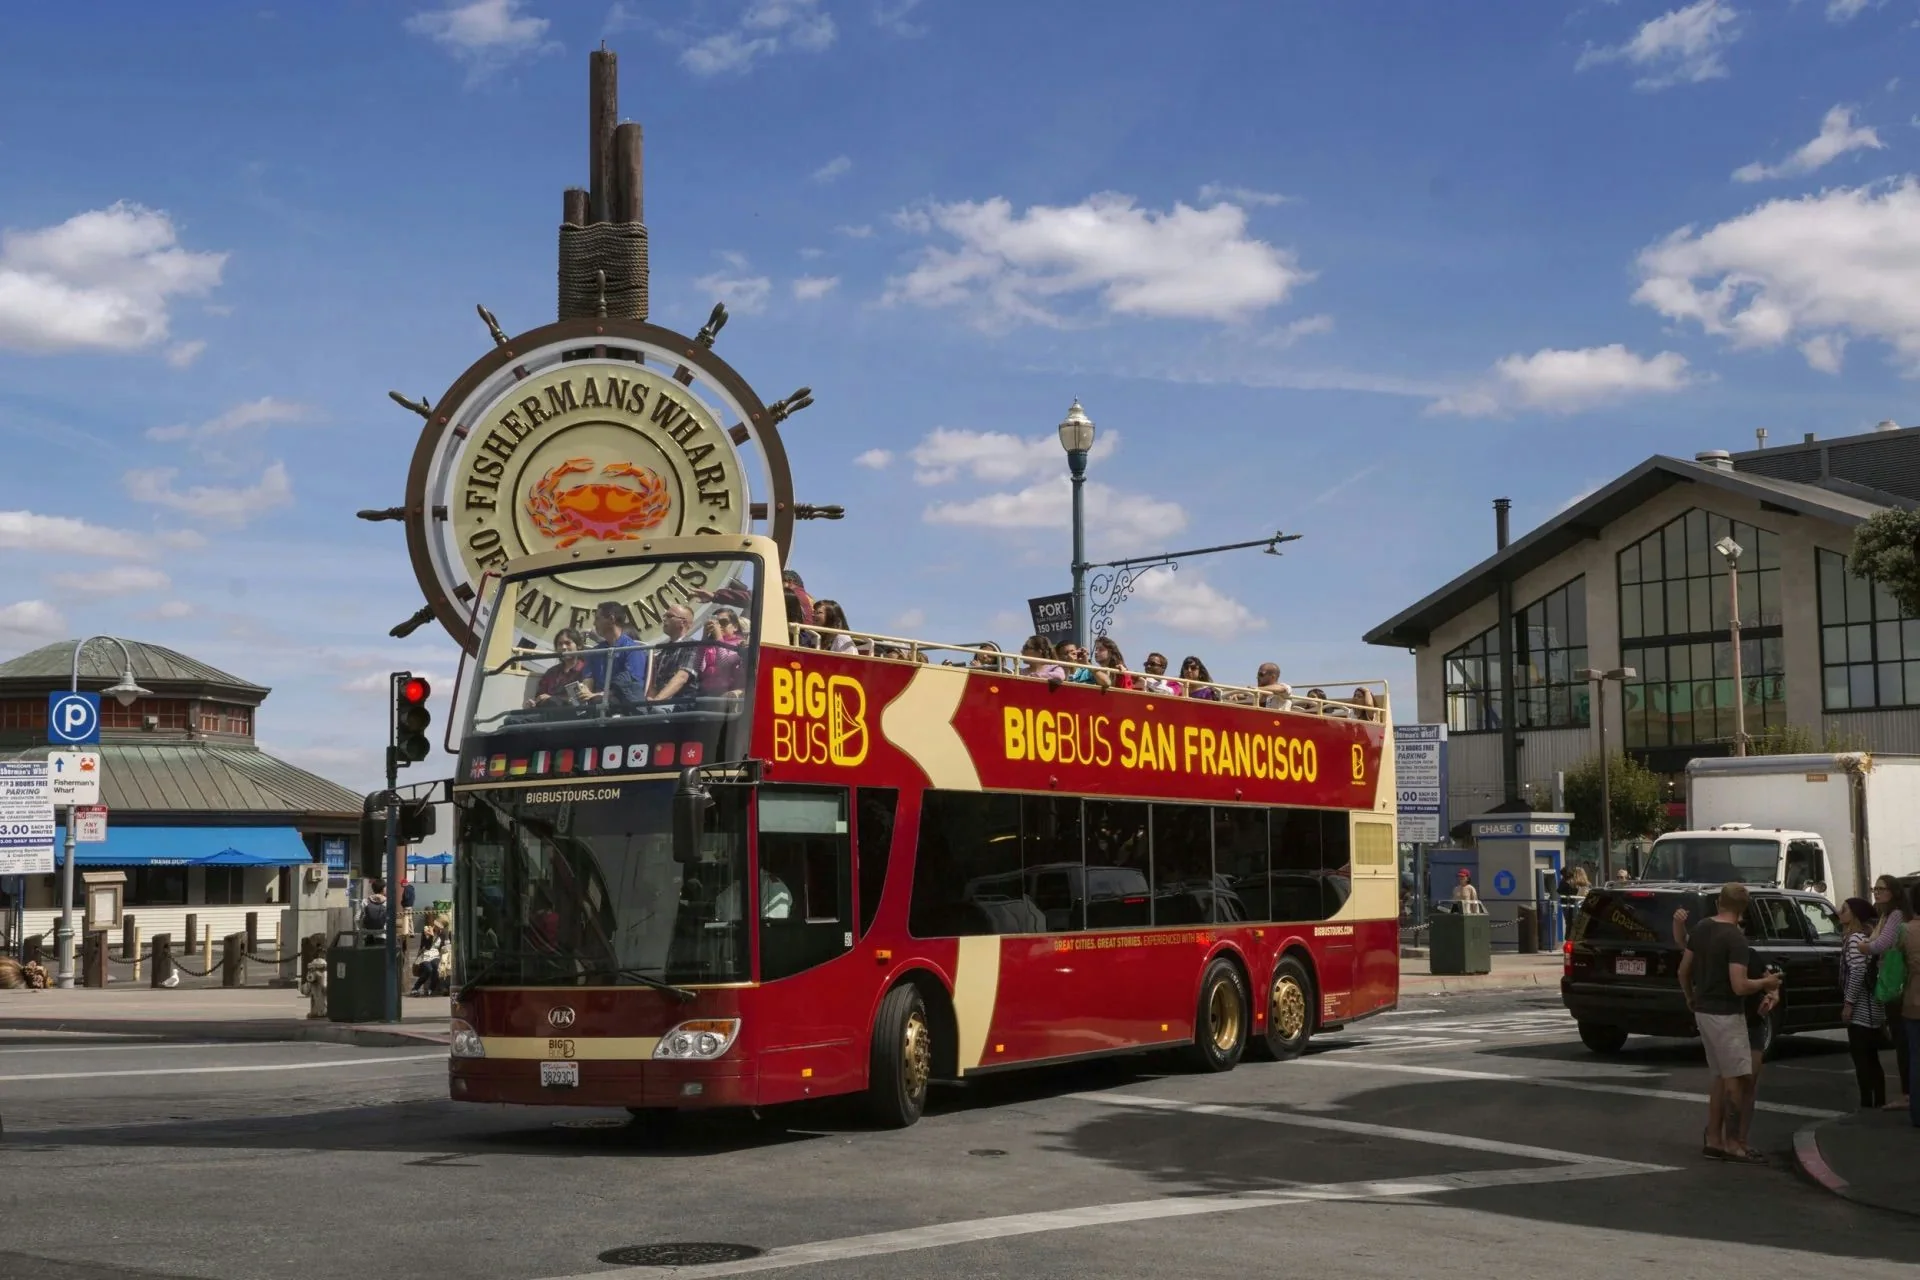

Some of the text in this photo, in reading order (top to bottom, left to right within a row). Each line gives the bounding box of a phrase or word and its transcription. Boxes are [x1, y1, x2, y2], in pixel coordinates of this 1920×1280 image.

[466, 376, 731, 513] FISHERMANS WHARF
[469, 528, 510, 573] OF
[1038, 602, 1067, 618] PORT
[1037, 621, 1072, 633] 150 YEARS
[773, 667, 827, 719] BIG
[774, 719, 828, 764] BUS
[1119, 718, 1177, 773] SAN
[1184, 726, 1318, 783] FRANCISCO
[1398, 752, 1427, 760] PARKING
[0, 767, 31, 775] sherman's
[526, 788, 621, 804] BIGBUSTOURS.COM
[1479, 824, 1513, 834] CHASE
[1535, 824, 1558, 833] CHASE
[1055, 939, 1074, 951] GREAT
[1075, 938, 1096, 949] CITIES.
[1097, 938, 1116, 949] GREAT
[1118, 936, 1143, 948] STORIES.
[1143, 935, 1181, 946] EXPERIENCED
[1181, 934, 1195, 944] WITH
[1196, 933, 1205, 943] BIG
[549, 1040, 563, 1048] BIG
[543, 1071, 575, 1083] 38293C1
